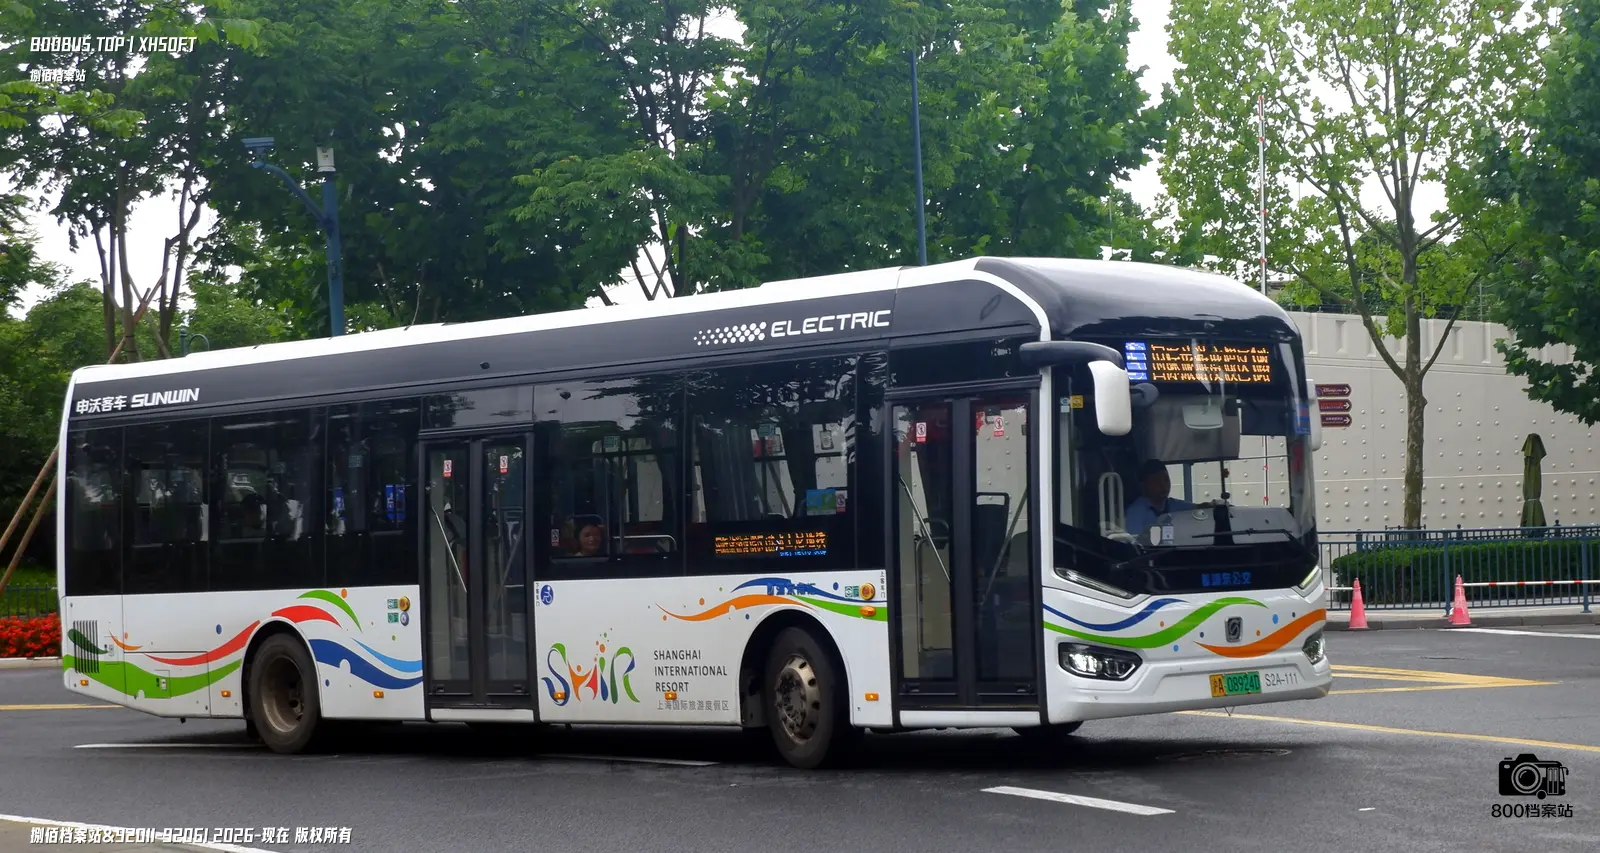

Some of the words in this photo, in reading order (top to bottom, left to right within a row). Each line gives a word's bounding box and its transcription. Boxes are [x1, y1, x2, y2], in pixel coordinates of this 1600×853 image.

[770, 309, 892, 338] ELECTRIC
[75, 395, 127, 415] 申沃客车
[130, 388, 200, 408] SUNWIN
[653, 649, 702, 661] SHANGHAI
[654, 665, 728, 676] INTERNATIONAL
[1264, 672, 1299, 687] S2A-111
[655, 681, 690, 693] RESORT
[657, 699, 730, 711] 上海国际旅游度假区
